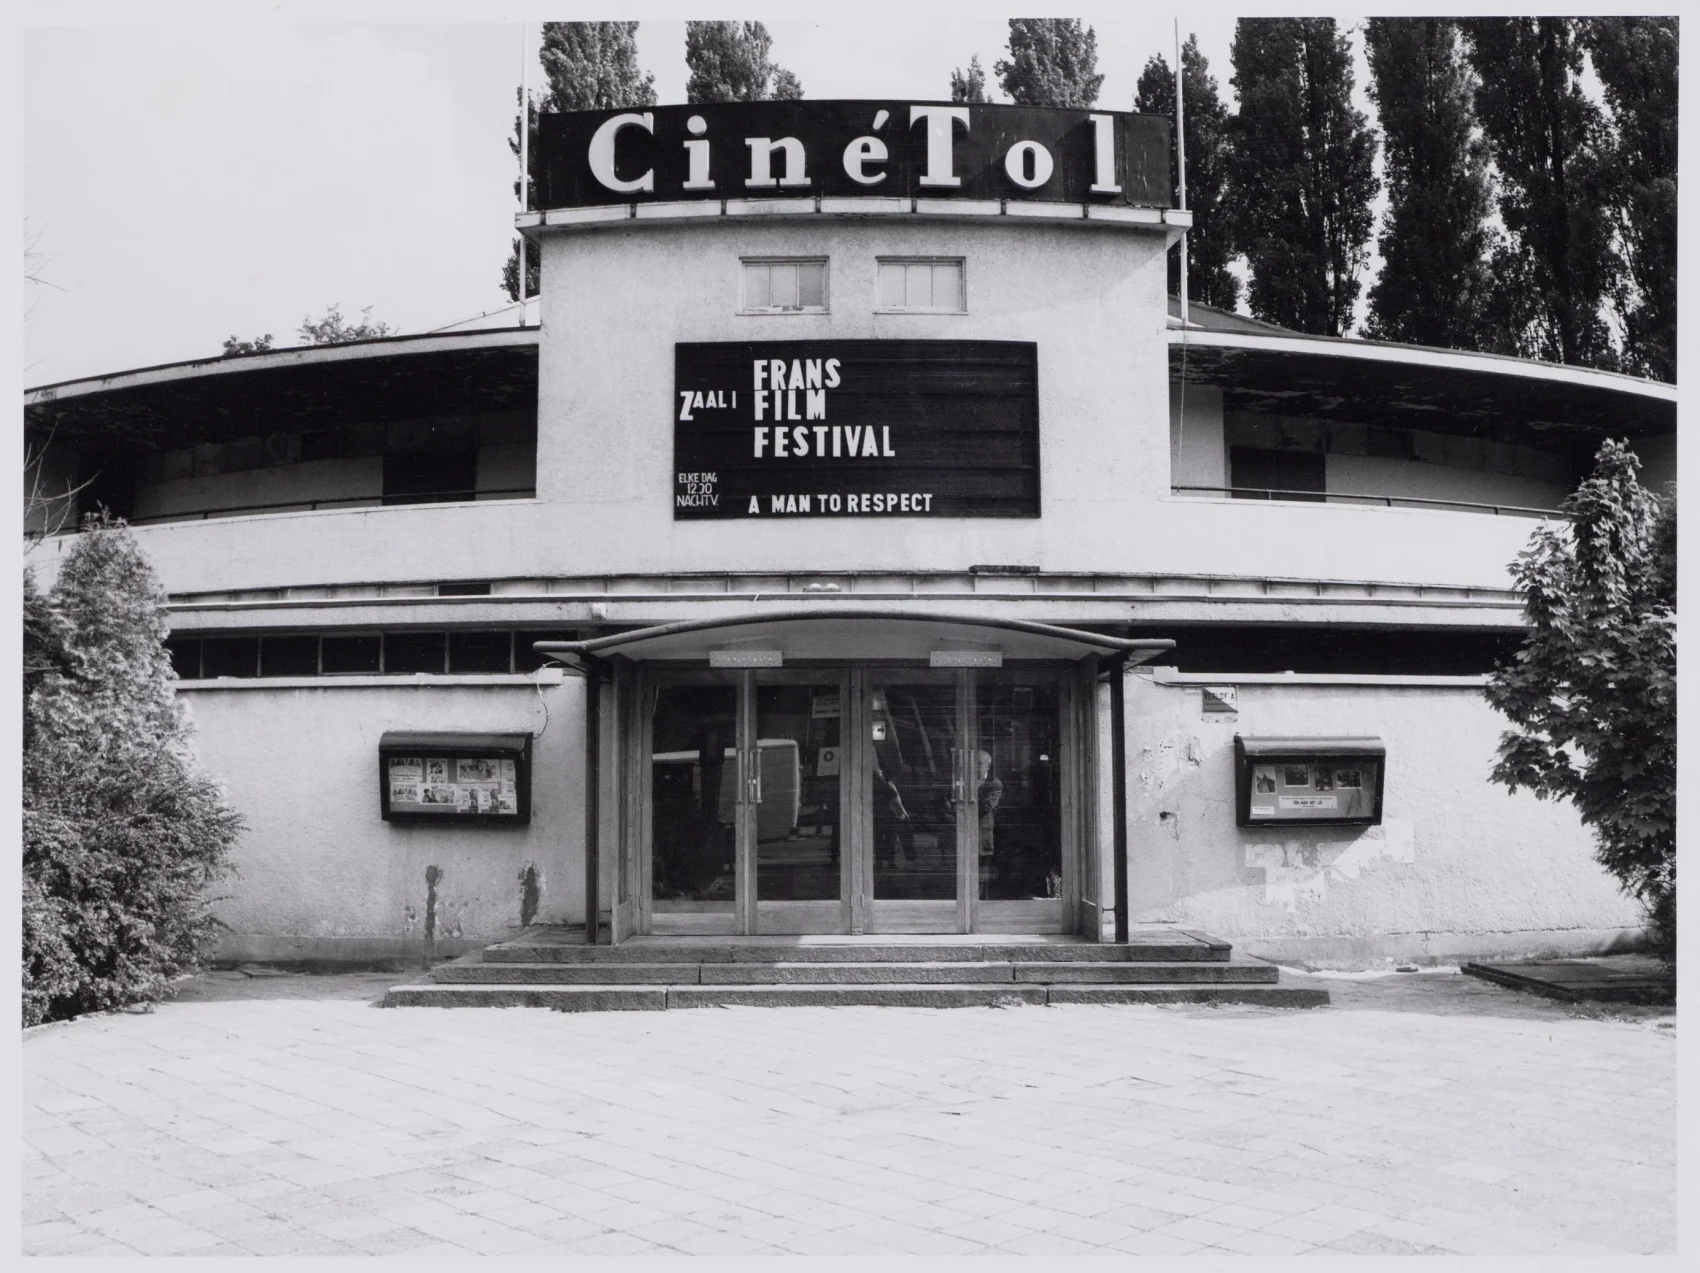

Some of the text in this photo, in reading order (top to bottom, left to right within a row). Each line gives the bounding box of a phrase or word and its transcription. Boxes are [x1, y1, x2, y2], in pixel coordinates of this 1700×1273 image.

[754, 358, 841, 390] FRANS
[679, 391, 727, 421] ZAAL
[754, 389, 826, 421] FILM
[754, 425, 896, 458] FESTIVAL
[678, 472, 718, 483] ELKE DAG
[748, 492, 933, 514] A MAN TO RESPECT
